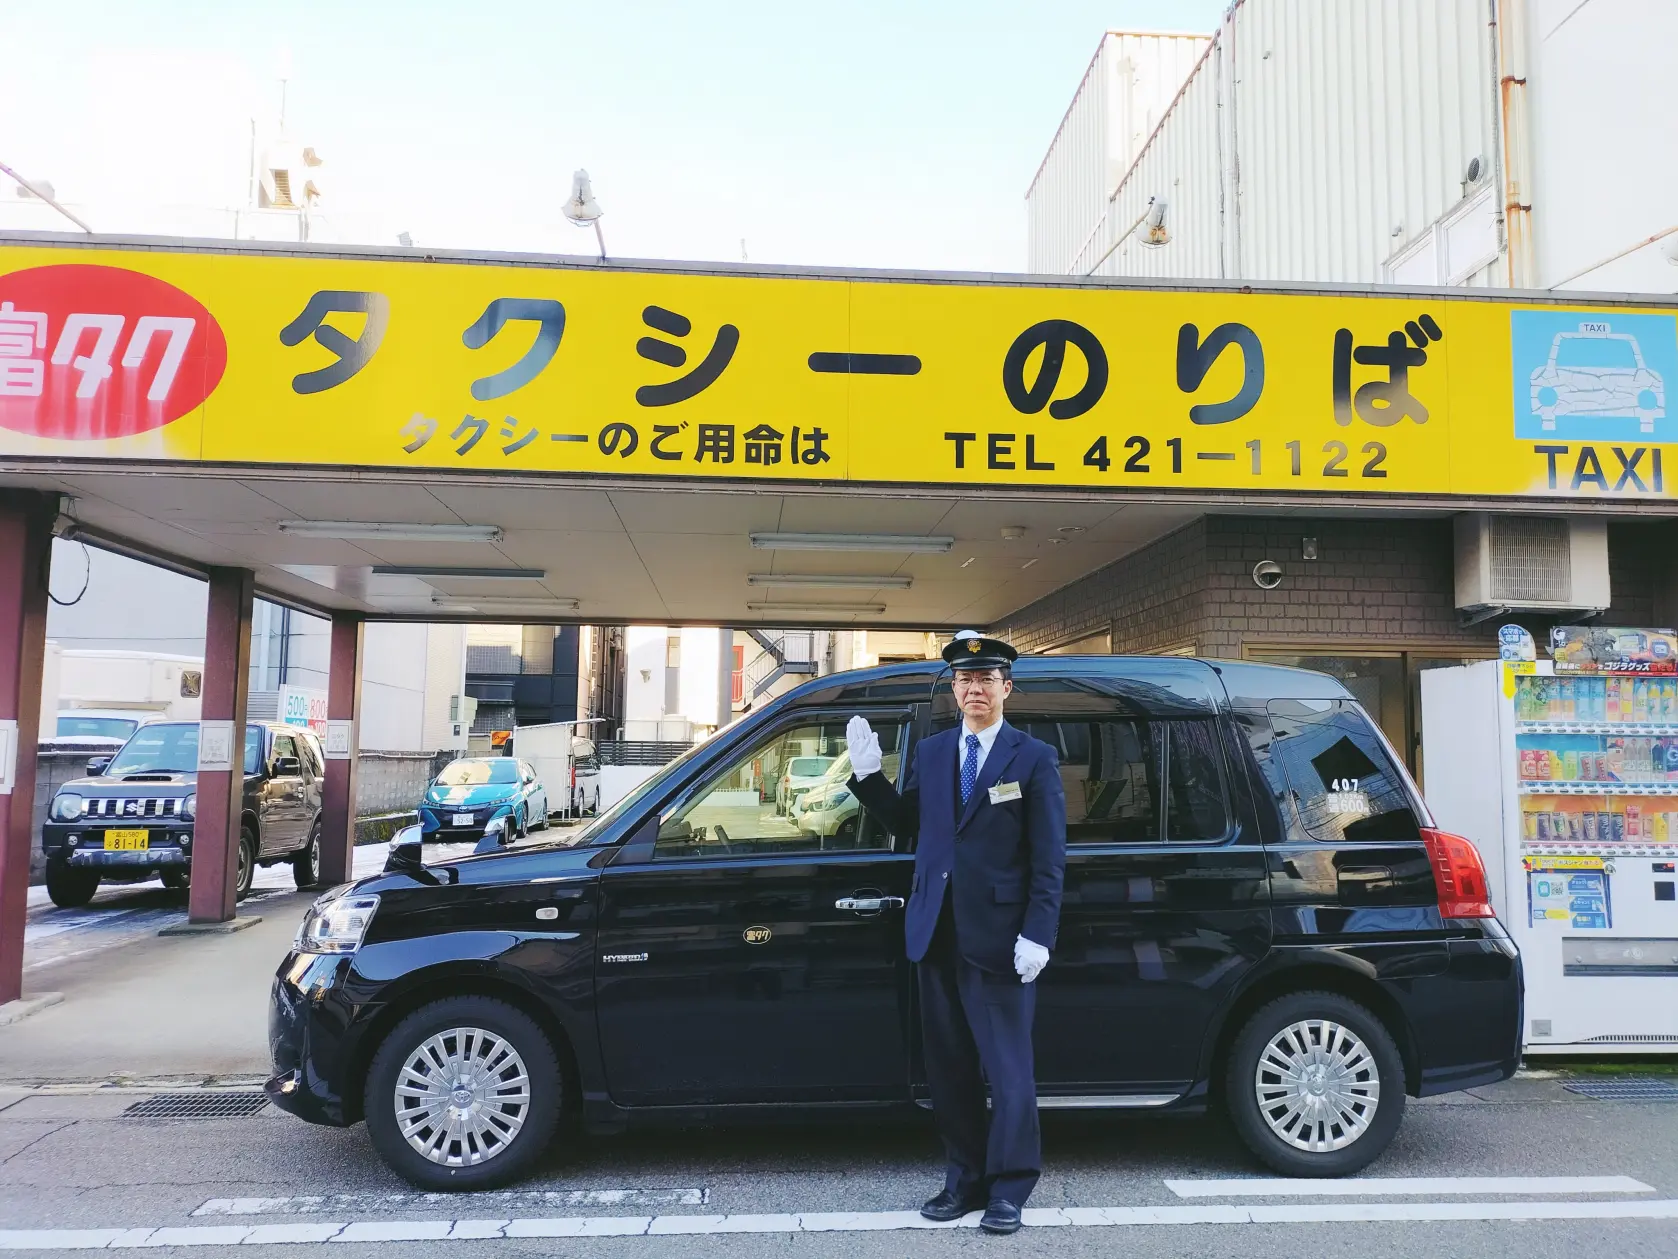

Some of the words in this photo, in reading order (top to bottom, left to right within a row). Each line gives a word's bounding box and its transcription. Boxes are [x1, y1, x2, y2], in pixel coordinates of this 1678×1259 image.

[1583, 323, 1606, 332] TAXI
[280, 290, 1443, 428] タクシーのりば
[400, 411, 831, 466] タクシーのご用命は
[944, 432, 1055, 472] TEL
[1533, 444, 1662, 493] TAXI
[1332, 778, 1359, 792] 407
